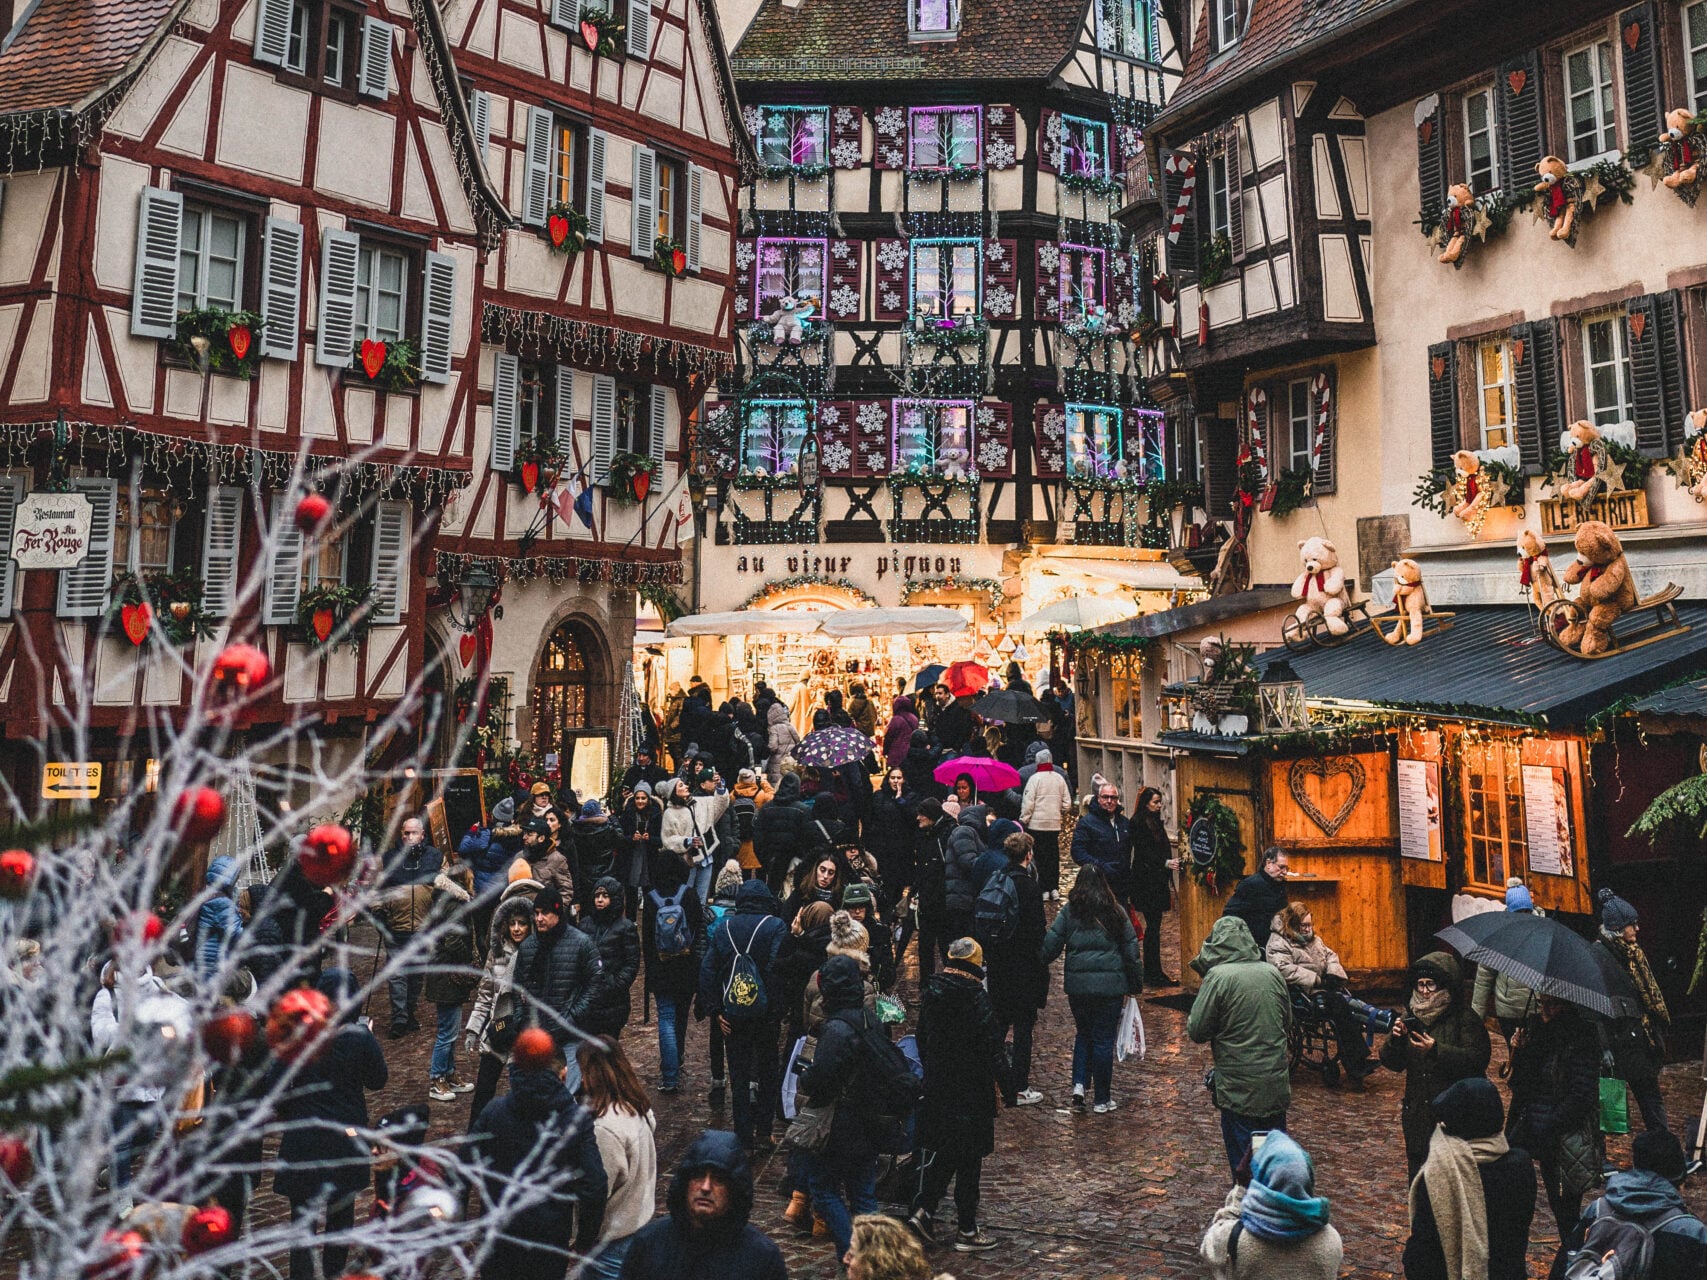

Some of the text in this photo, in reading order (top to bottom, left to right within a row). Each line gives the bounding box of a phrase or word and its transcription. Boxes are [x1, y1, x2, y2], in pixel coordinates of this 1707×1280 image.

[33, 507, 76, 521] Restaurant
[1551, 501, 1570, 531] LE
[62, 524, 77, 535] Au
[16, 527, 83, 558] Fer Rouge
[737, 548, 962, 581] au vieux pignon
[47, 767, 99, 777] TOILTES
